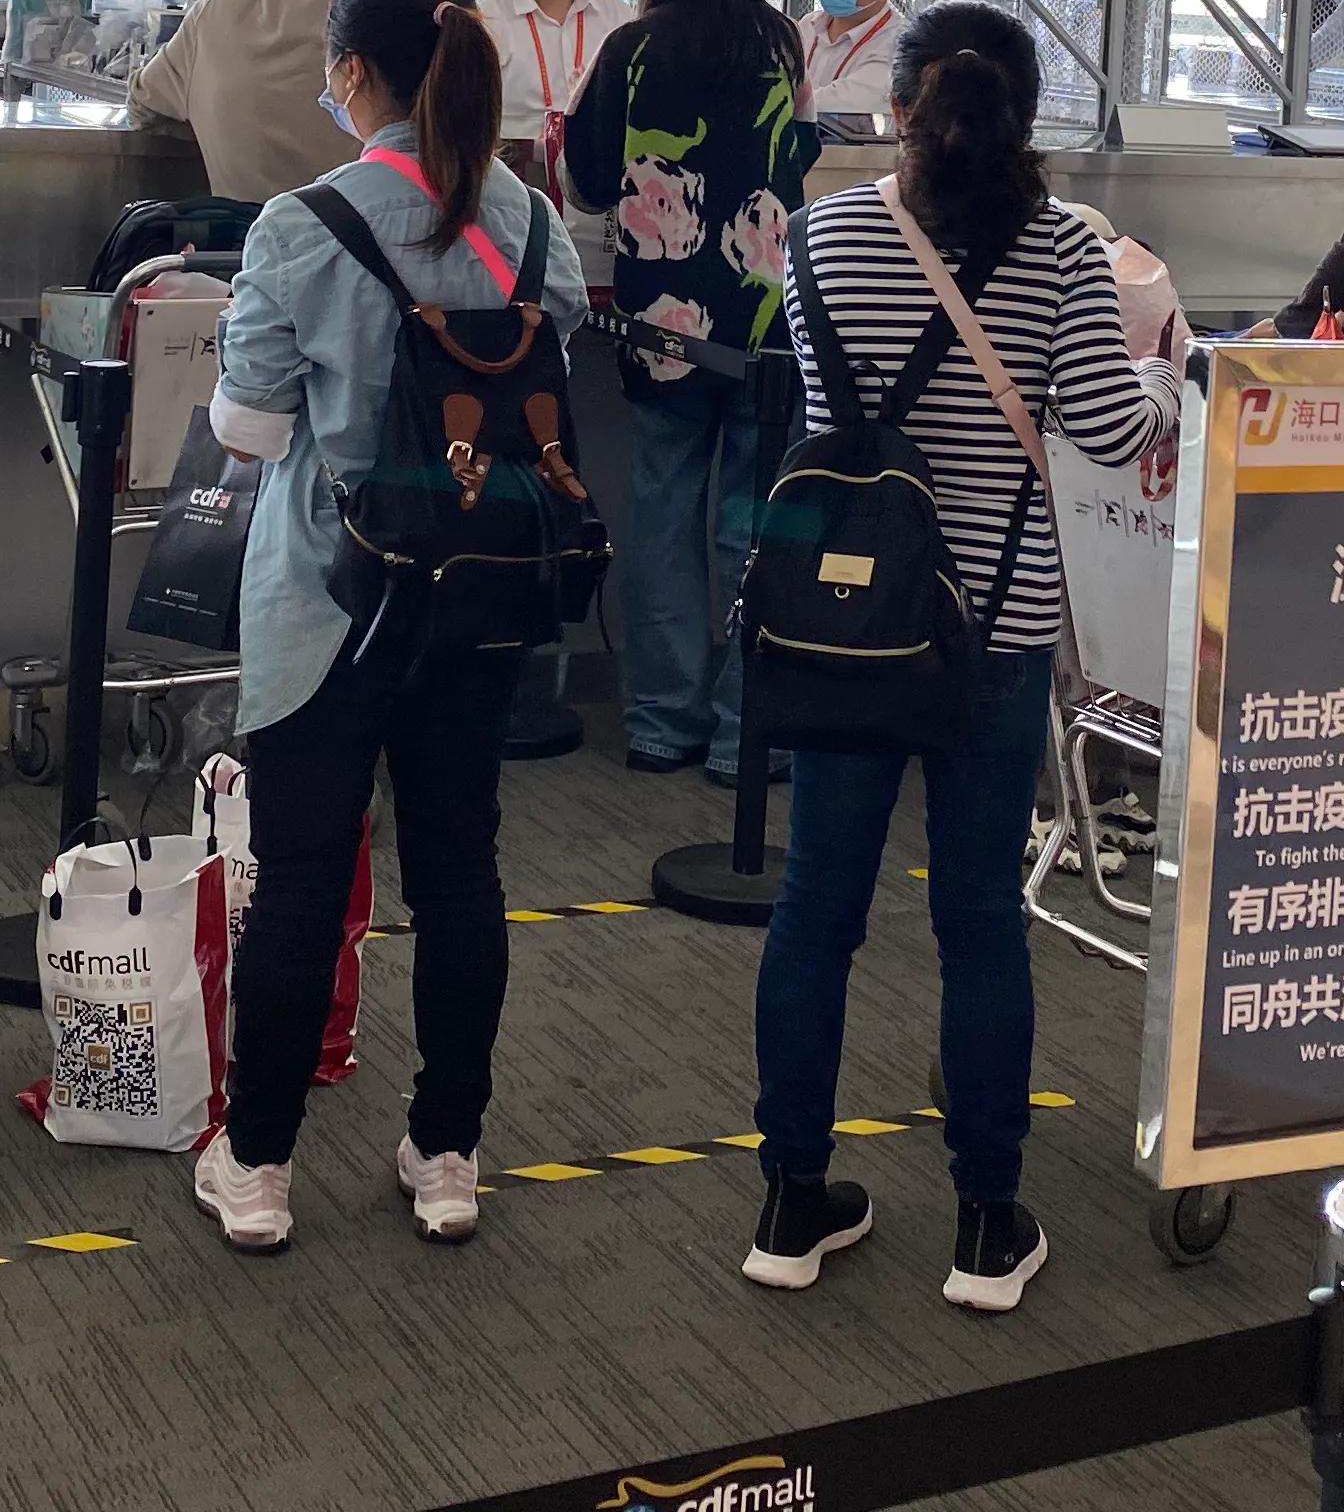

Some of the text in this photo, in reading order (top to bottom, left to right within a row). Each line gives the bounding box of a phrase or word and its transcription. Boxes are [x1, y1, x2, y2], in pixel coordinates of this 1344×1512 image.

[190, 486, 223, 508] cdf
[1232, 755, 1245, 774] is
[1249, 748, 1335, 776] everyone's
[1256, 848, 1277, 868] To
[1280, 844, 1319, 868] fight
[47, 947, 151, 976] cdfmall
[1222, 948, 1255, 970] Line
[1259, 948, 1281, 968] up
[1284, 943, 1299, 962] in
[1303, 945, 1323, 961] an
